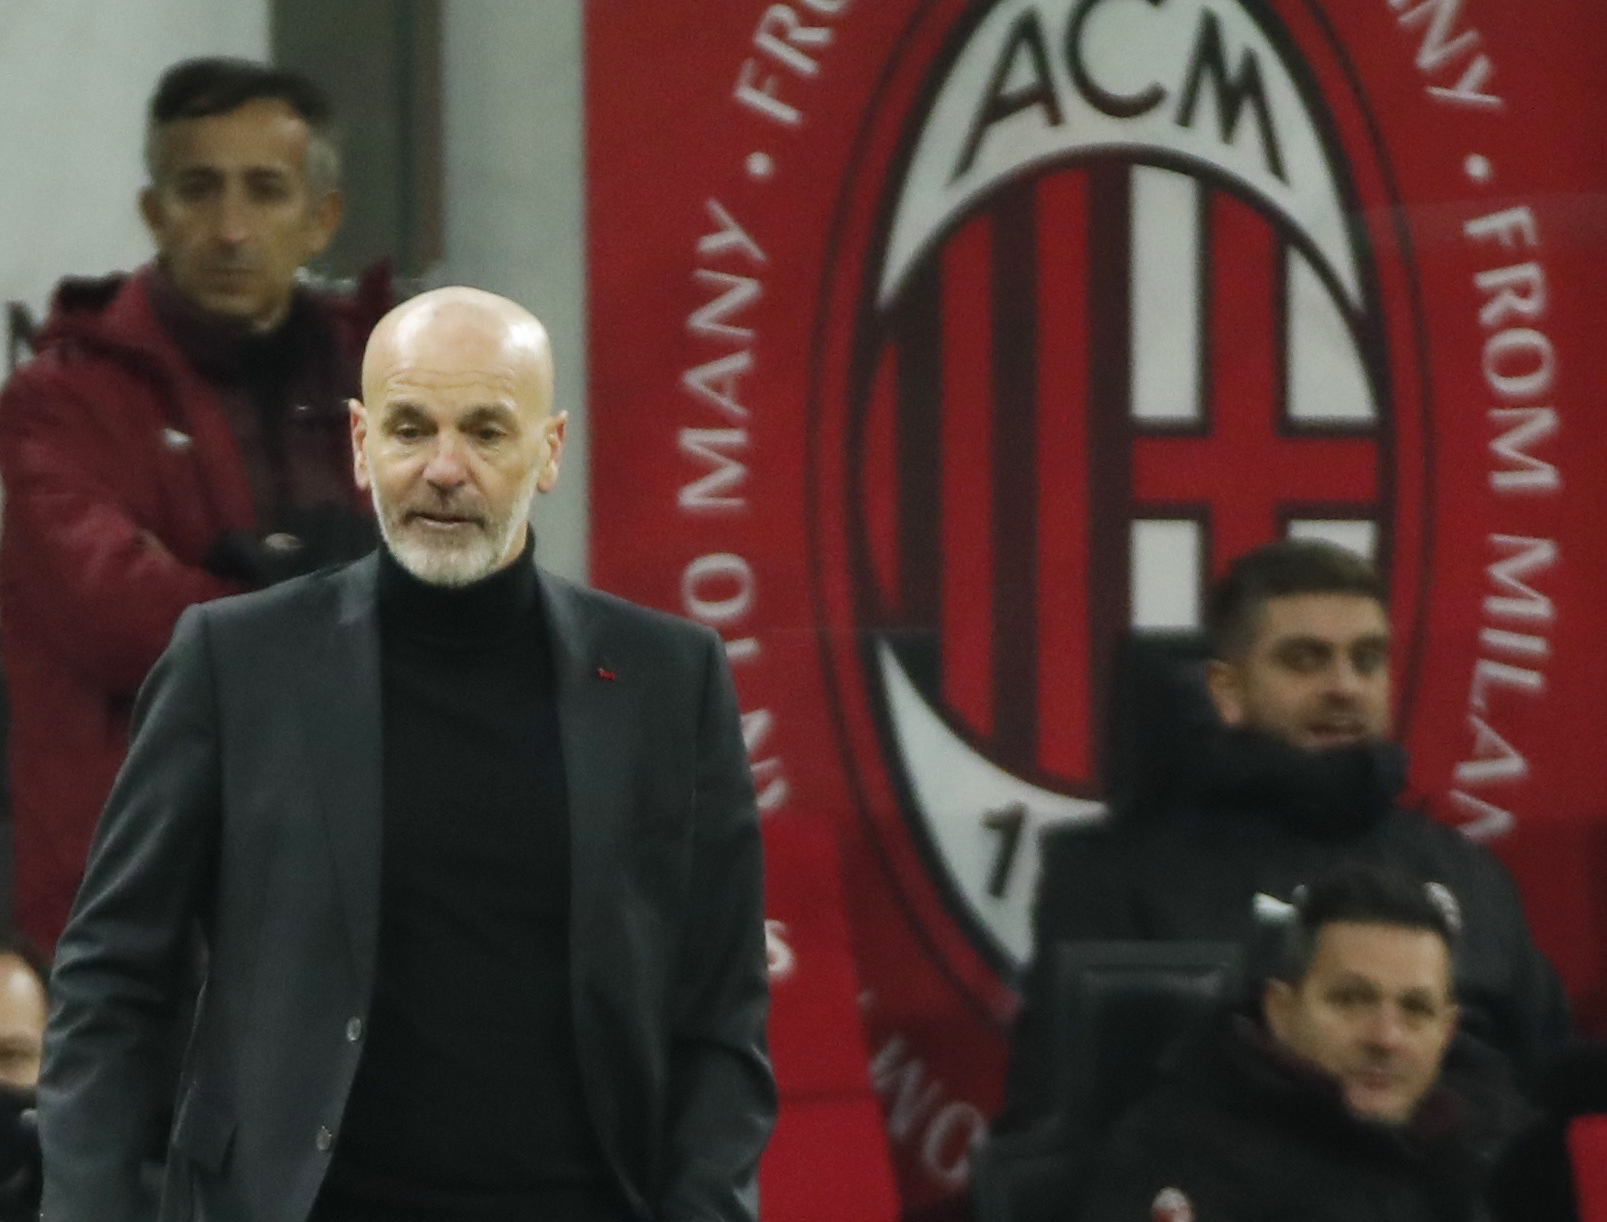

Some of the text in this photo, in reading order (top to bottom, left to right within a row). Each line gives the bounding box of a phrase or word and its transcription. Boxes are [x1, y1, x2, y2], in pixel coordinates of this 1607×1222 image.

[946, 0, 1292, 188] ACM
[1387, 0, 1506, 110] NY
[677, 197, 768, 510] MANY
[733, 0, 851, 126] FR
[1463, 205, 1562, 493] FROM
